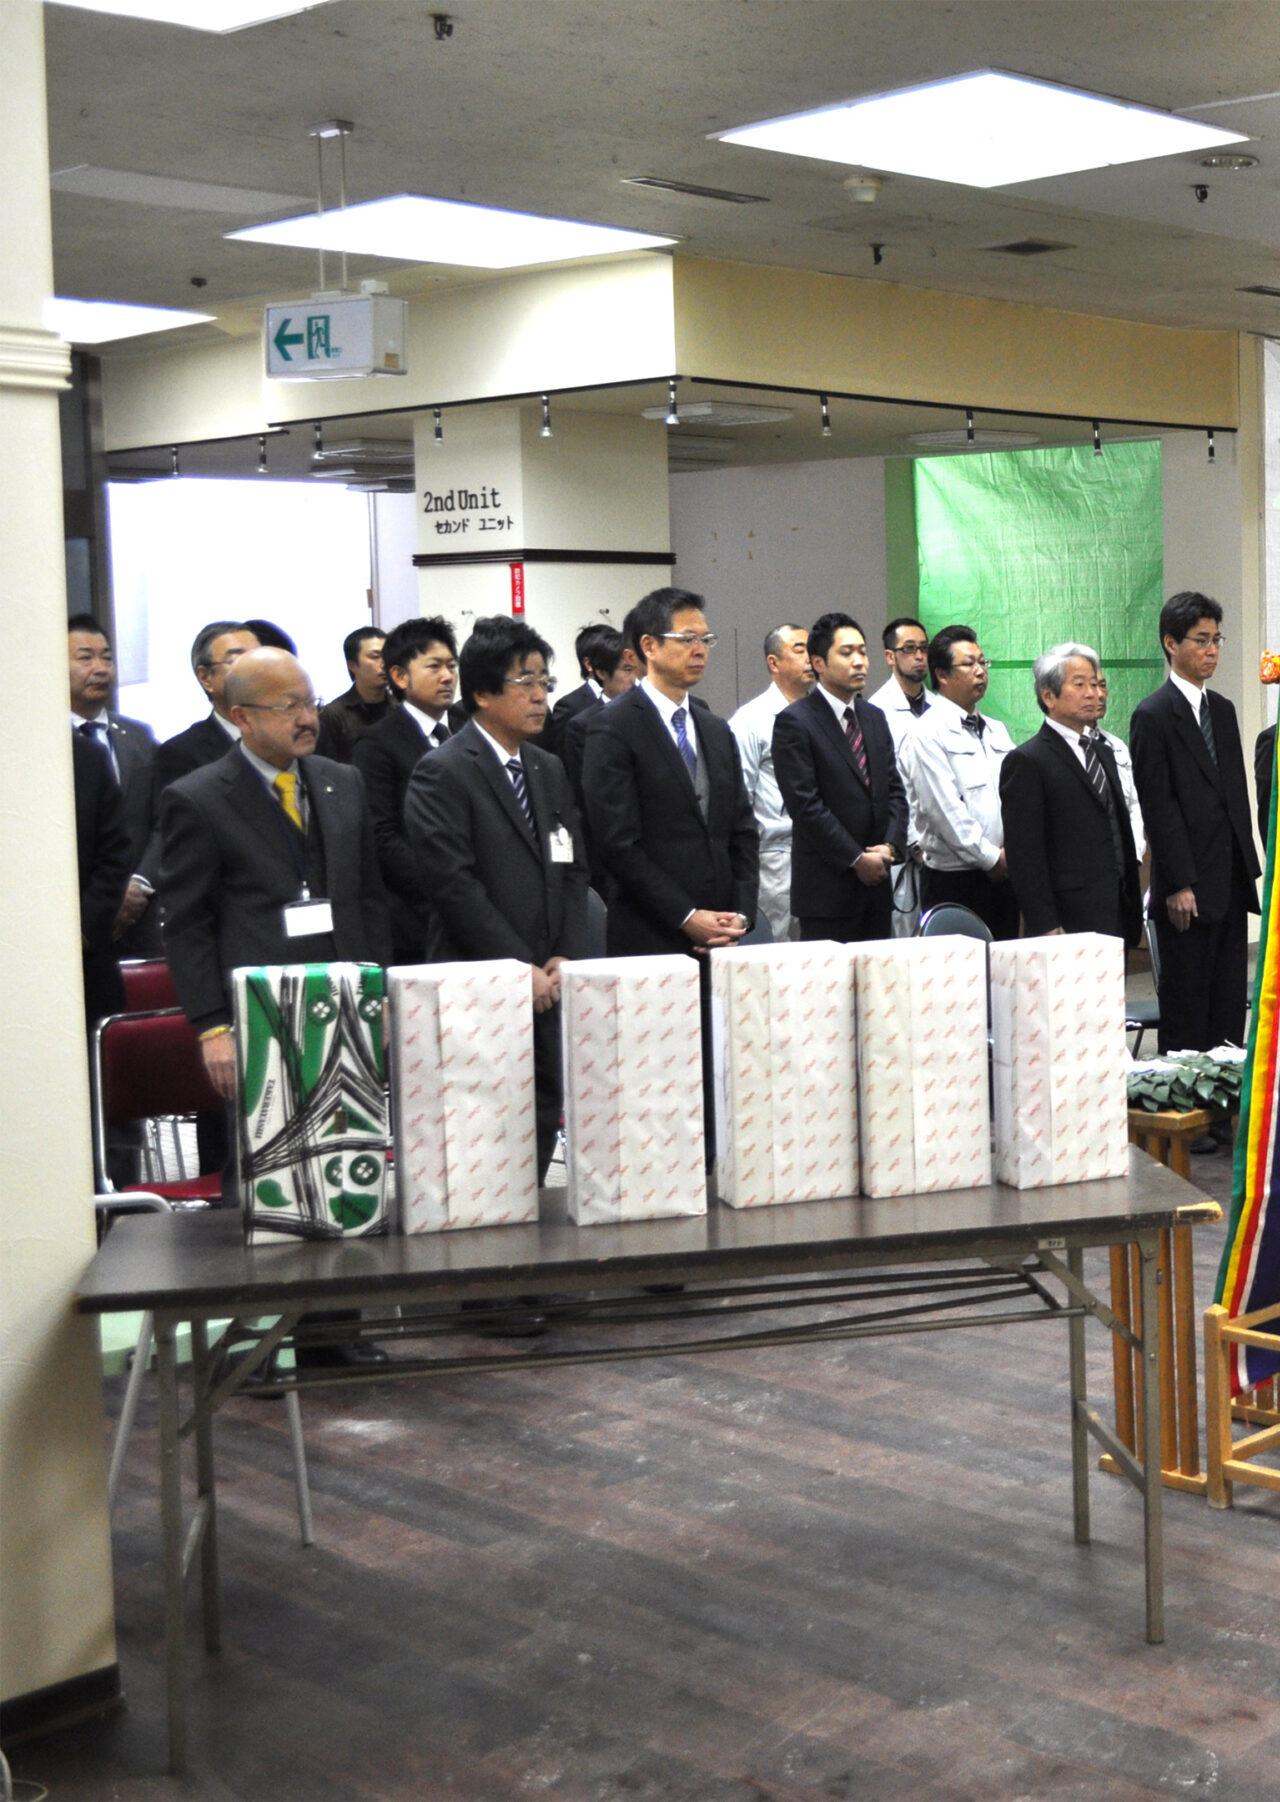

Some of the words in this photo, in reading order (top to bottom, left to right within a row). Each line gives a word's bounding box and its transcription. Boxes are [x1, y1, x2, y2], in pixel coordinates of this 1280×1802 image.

[434, 518, 470, 534] セカンド
[478, 515, 515, 531] ユニット
